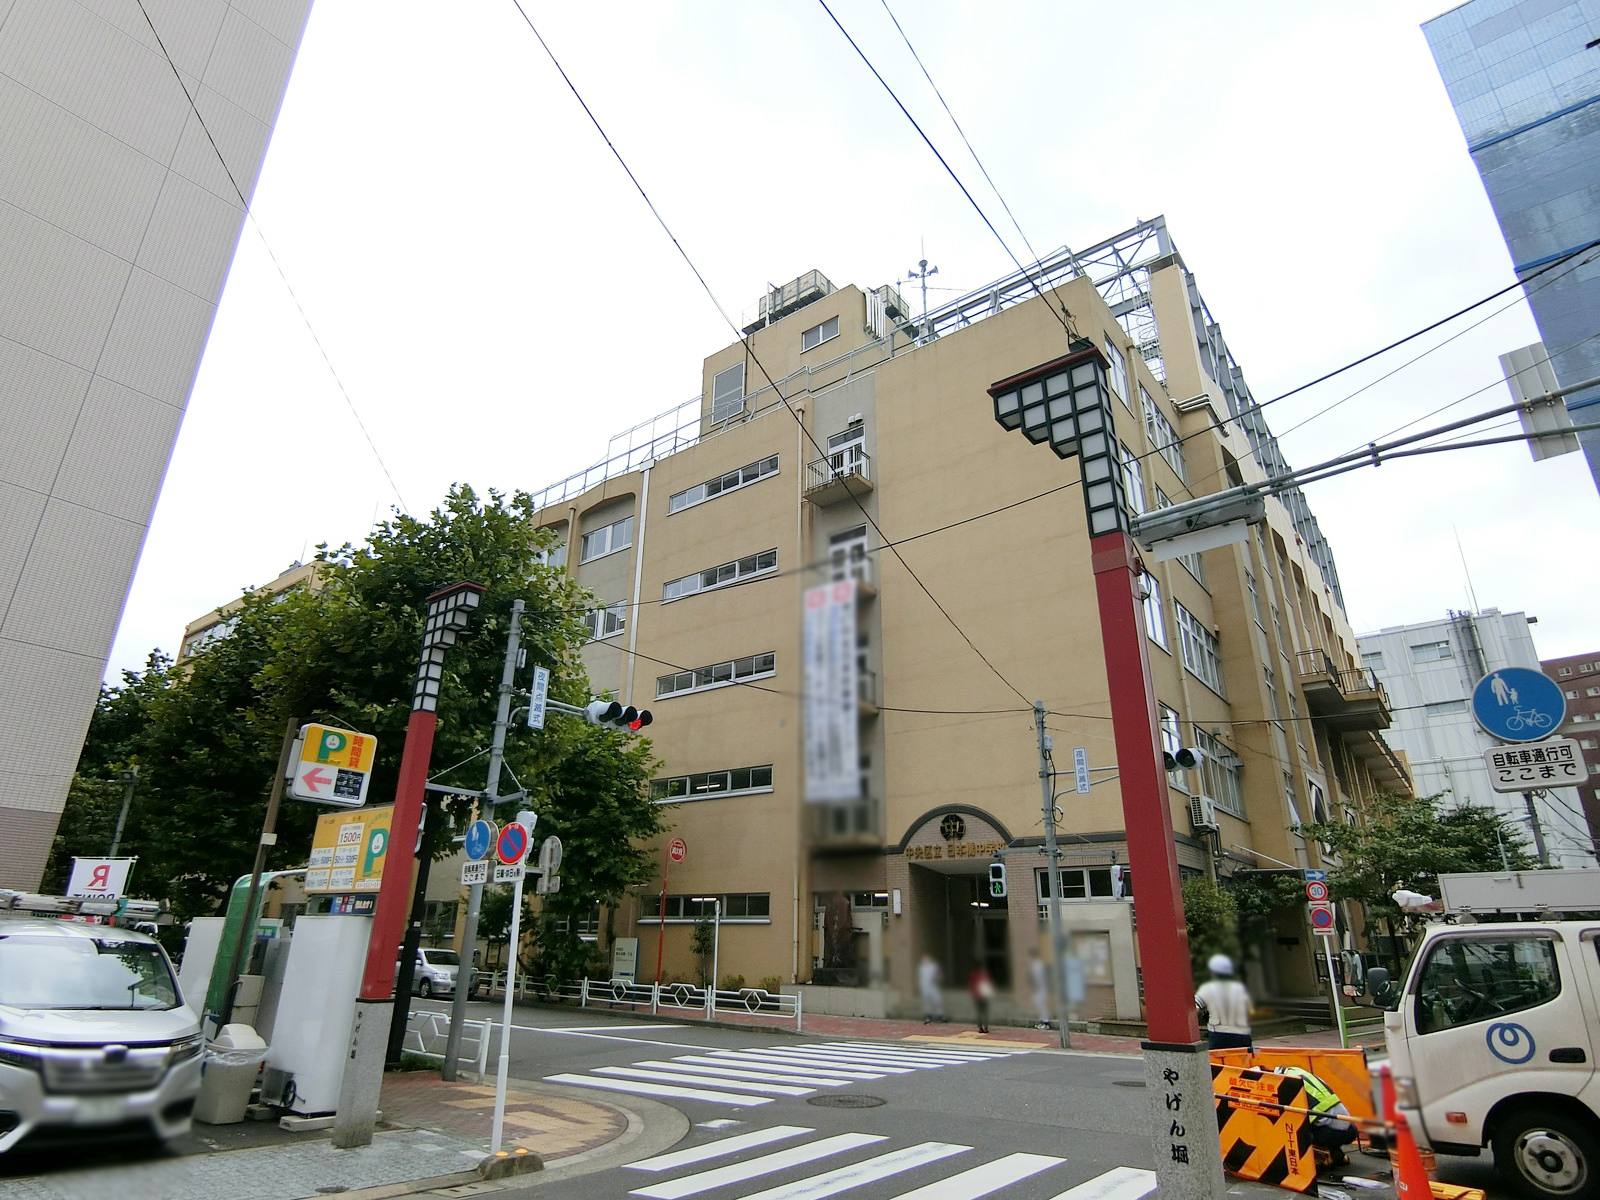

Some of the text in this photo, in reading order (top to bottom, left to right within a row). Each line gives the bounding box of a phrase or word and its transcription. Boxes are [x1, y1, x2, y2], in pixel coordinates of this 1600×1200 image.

[532, 671, 546, 724] 夜間点滅式
[348, 735, 364, 768] 時間貸
[1492, 745, 1573, 767] 自転車通行可
[1075, 750, 1087, 791] 夜間点滅式
[1497, 764, 1577, 782] ここまで
[340, 832, 361, 843] 1500円
[463, 873, 486, 882] ここまで
[1311, 886, 1324, 896] 30
[1229, 1076, 1276, 1093] 酸欠に注意
[1163, 1067, 1190, 1165] やげん堀
[1284, 1122, 1299, 1176] NTT東日本
